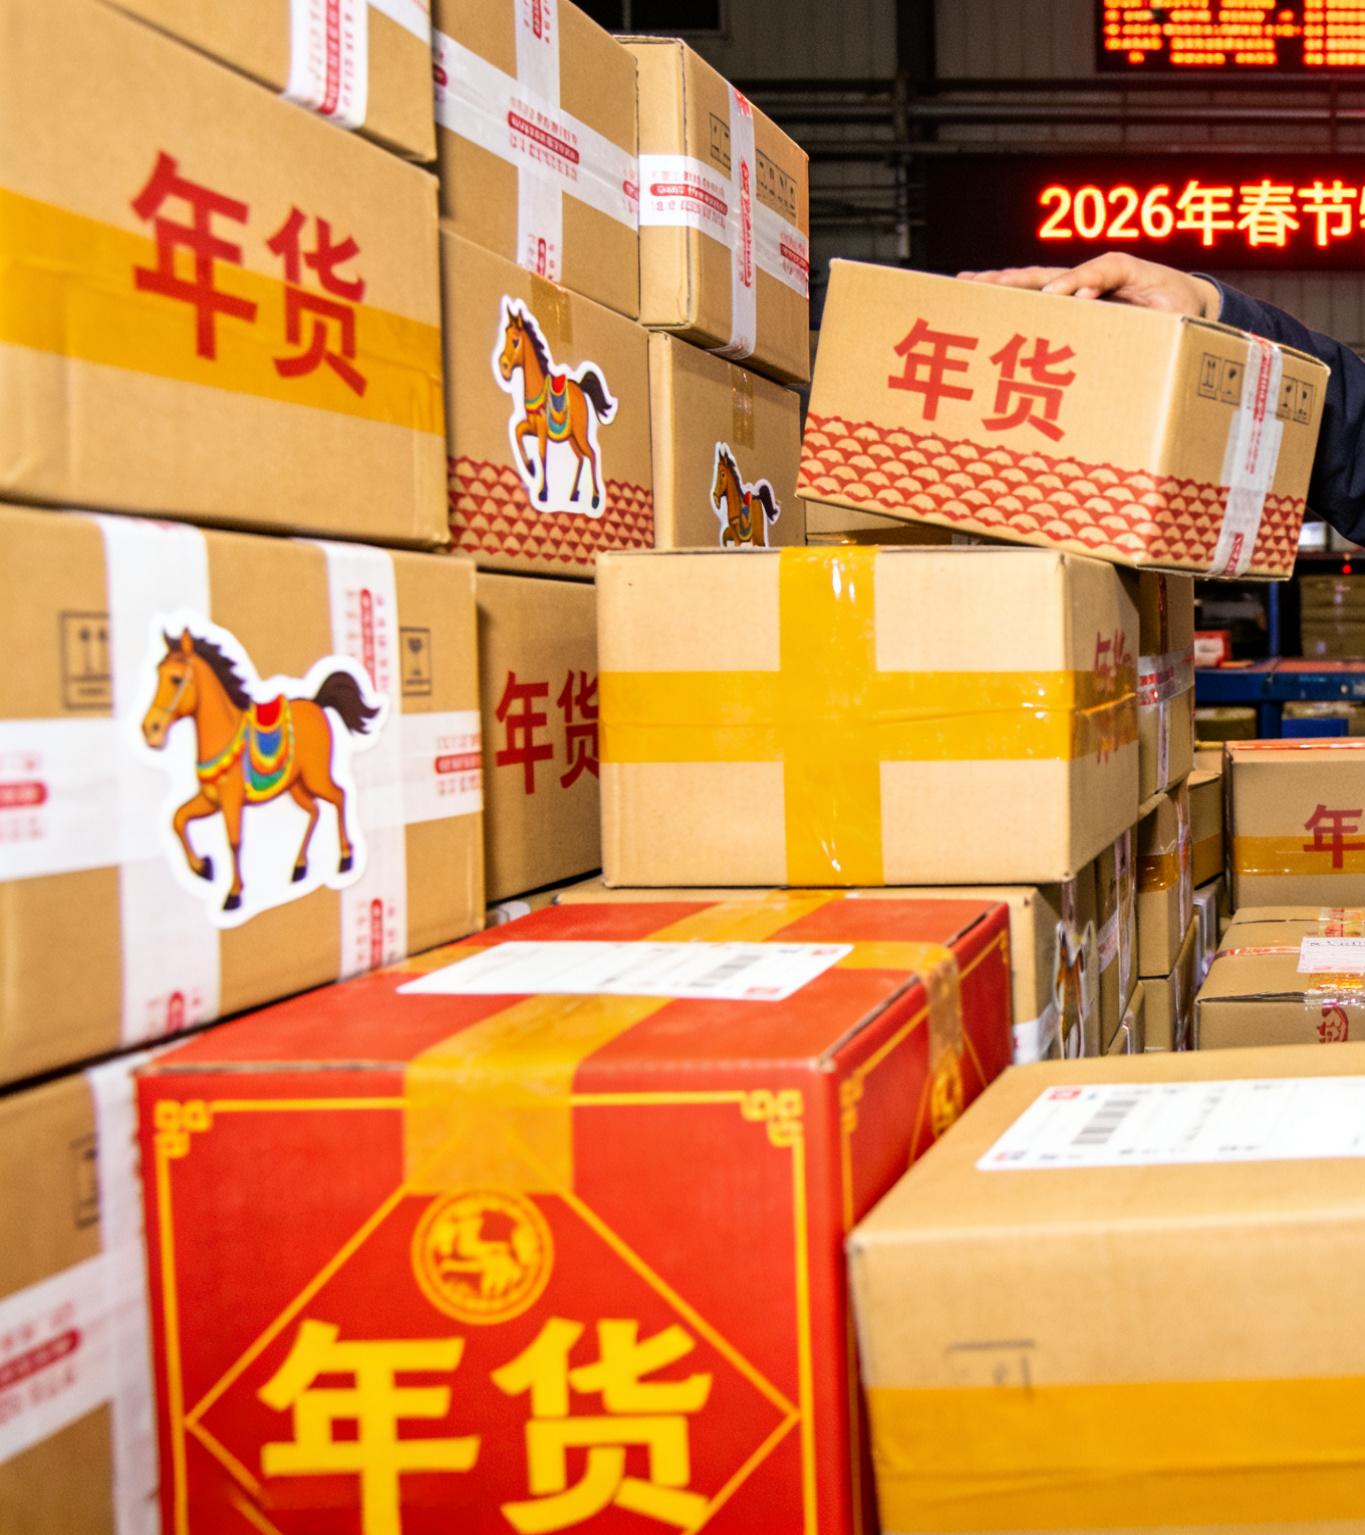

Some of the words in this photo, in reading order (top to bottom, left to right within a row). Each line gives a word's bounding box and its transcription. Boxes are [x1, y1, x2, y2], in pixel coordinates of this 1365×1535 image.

[131, 150, 368, 398] 年货
[888, 318, 1076, 442] 年货
[496, 670, 599, 795] 年货
[257, 1317, 712, 1535] 年货
